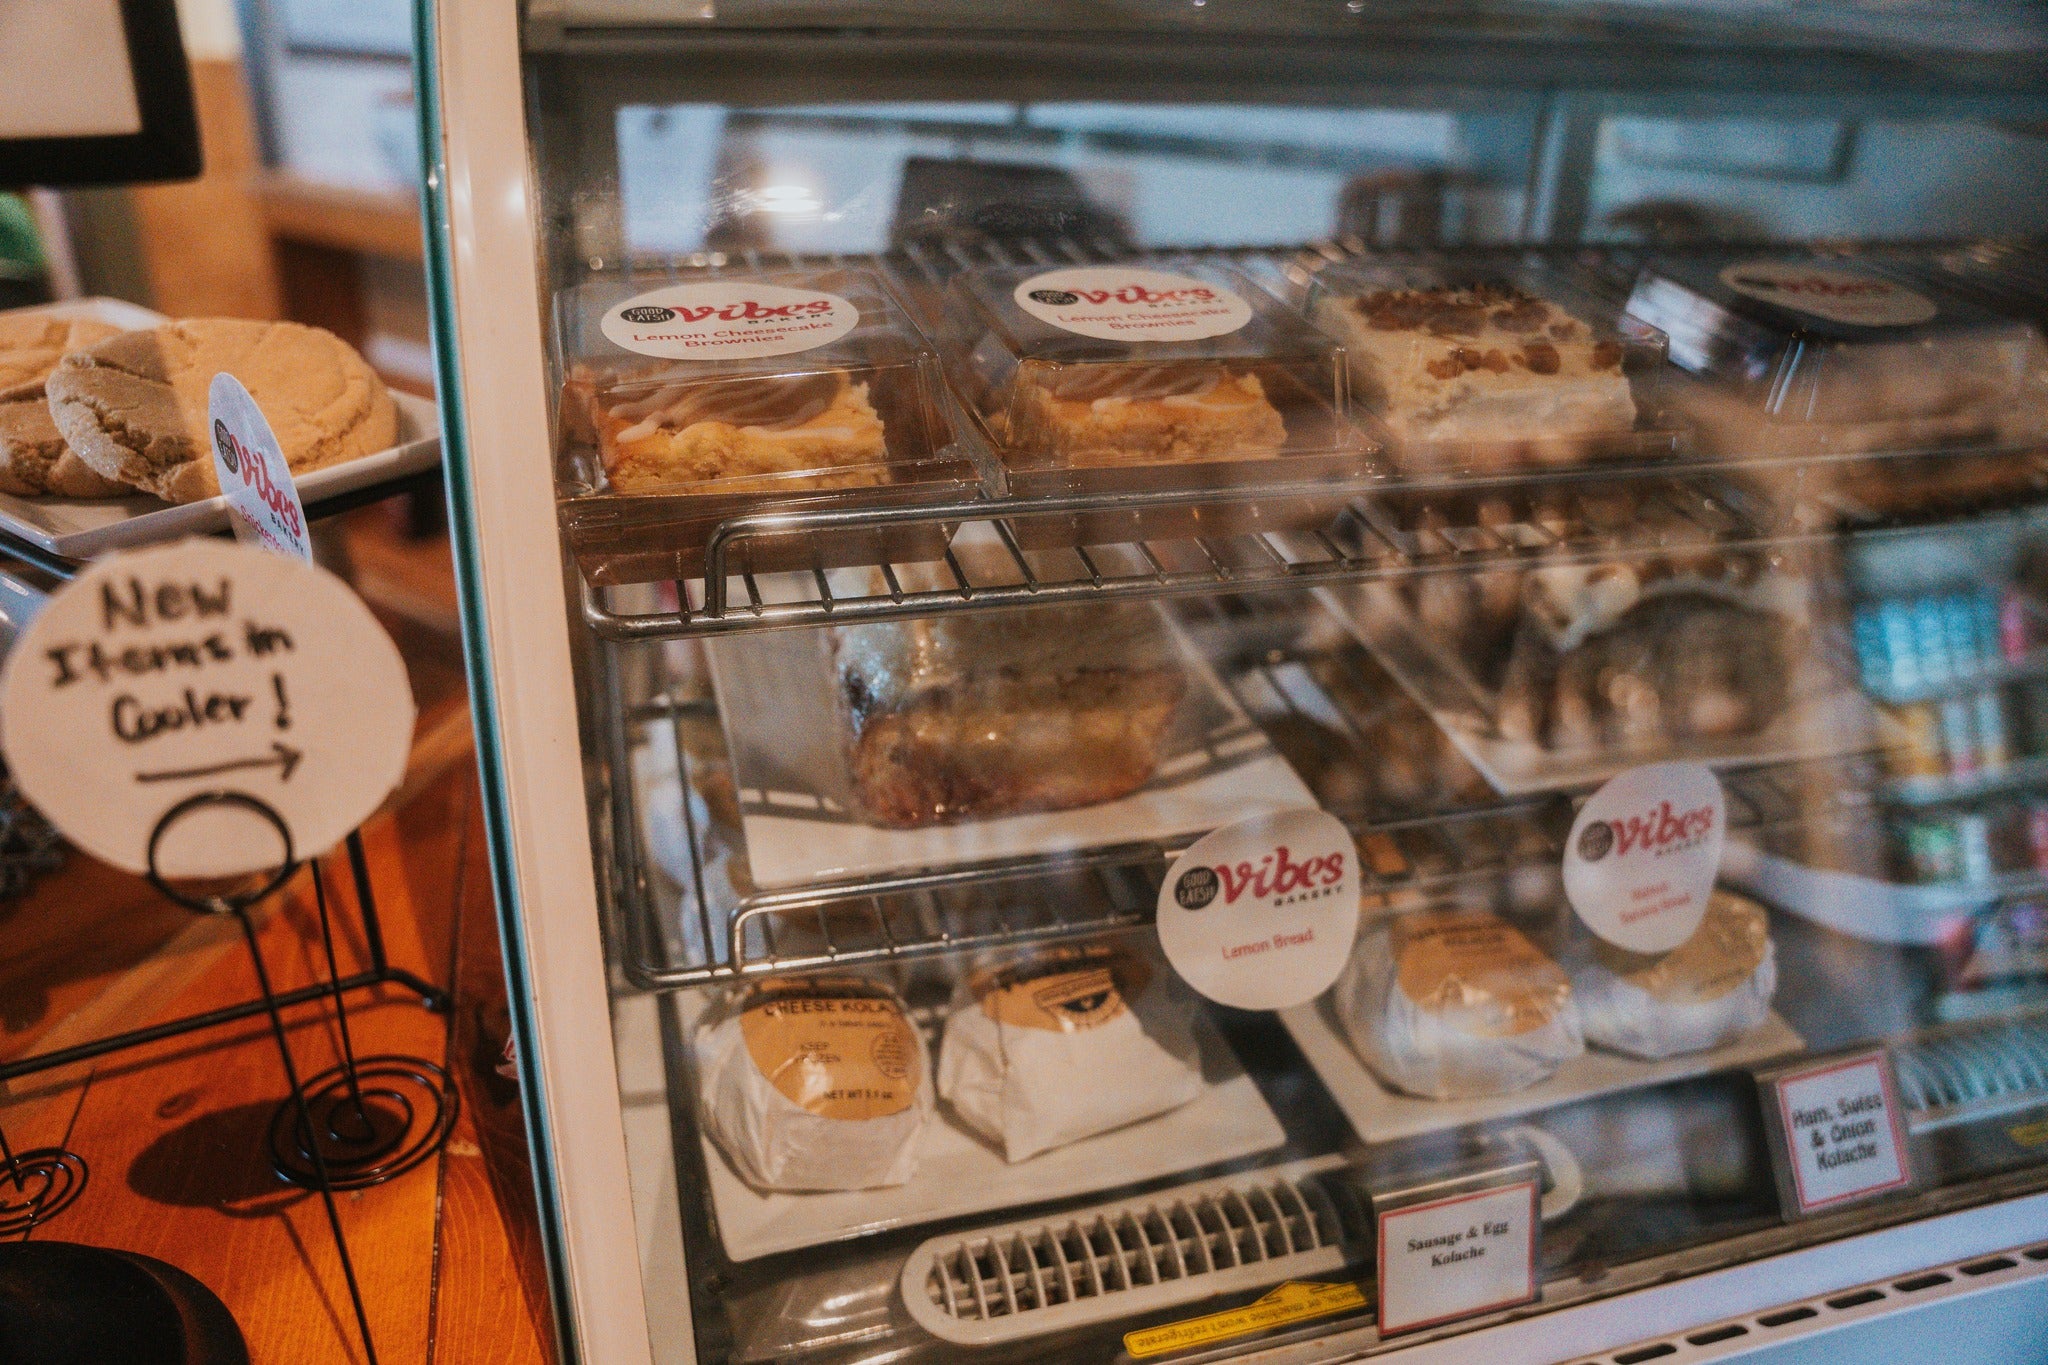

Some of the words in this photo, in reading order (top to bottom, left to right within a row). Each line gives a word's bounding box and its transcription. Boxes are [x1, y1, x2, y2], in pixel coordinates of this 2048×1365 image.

[1065, 285, 1216, 304] Vibes
[669, 300, 832, 322] Vibes
[748, 312, 836, 325] BAKERY
[1057, 314, 1122, 323] Lemon
[1126, 308, 1231, 321] Cheesecake
[633, 331, 707, 342] Lemon
[713, 321, 834, 338] Cheesecake
[1109, 320, 1196, 330] Brownies
[684, 334, 785, 348] Brownies
[230, 434, 301, 538] Vibes
[46, 636, 232, 688] Items
[245, 620, 295, 660] in
[1611, 802, 1714, 855] Vibes
[1214, 846, 1344, 904] Vibes
[1274, 883, 1344, 907] BAKERY
[1221, 940, 1270, 961] Lemon
[1273, 928, 1314, 949] Bread
[765, 1000, 837, 1016] CHEESE
[1837, 1094, 1882, 1117] Swiss
[1811, 1128, 1825, 1149] &
[1830, 1119, 1876, 1143] Onion
[1816, 1142, 1877, 1171] Kolache
[1407, 1232, 1462, 1252] Sausage
[1466, 1225, 1478, 1238] &
[1483, 1221, 1509, 1236] Egg
[1431, 1246, 1486, 1267] Kolache
[1138, 1326, 1208, 1348] refrigerate
